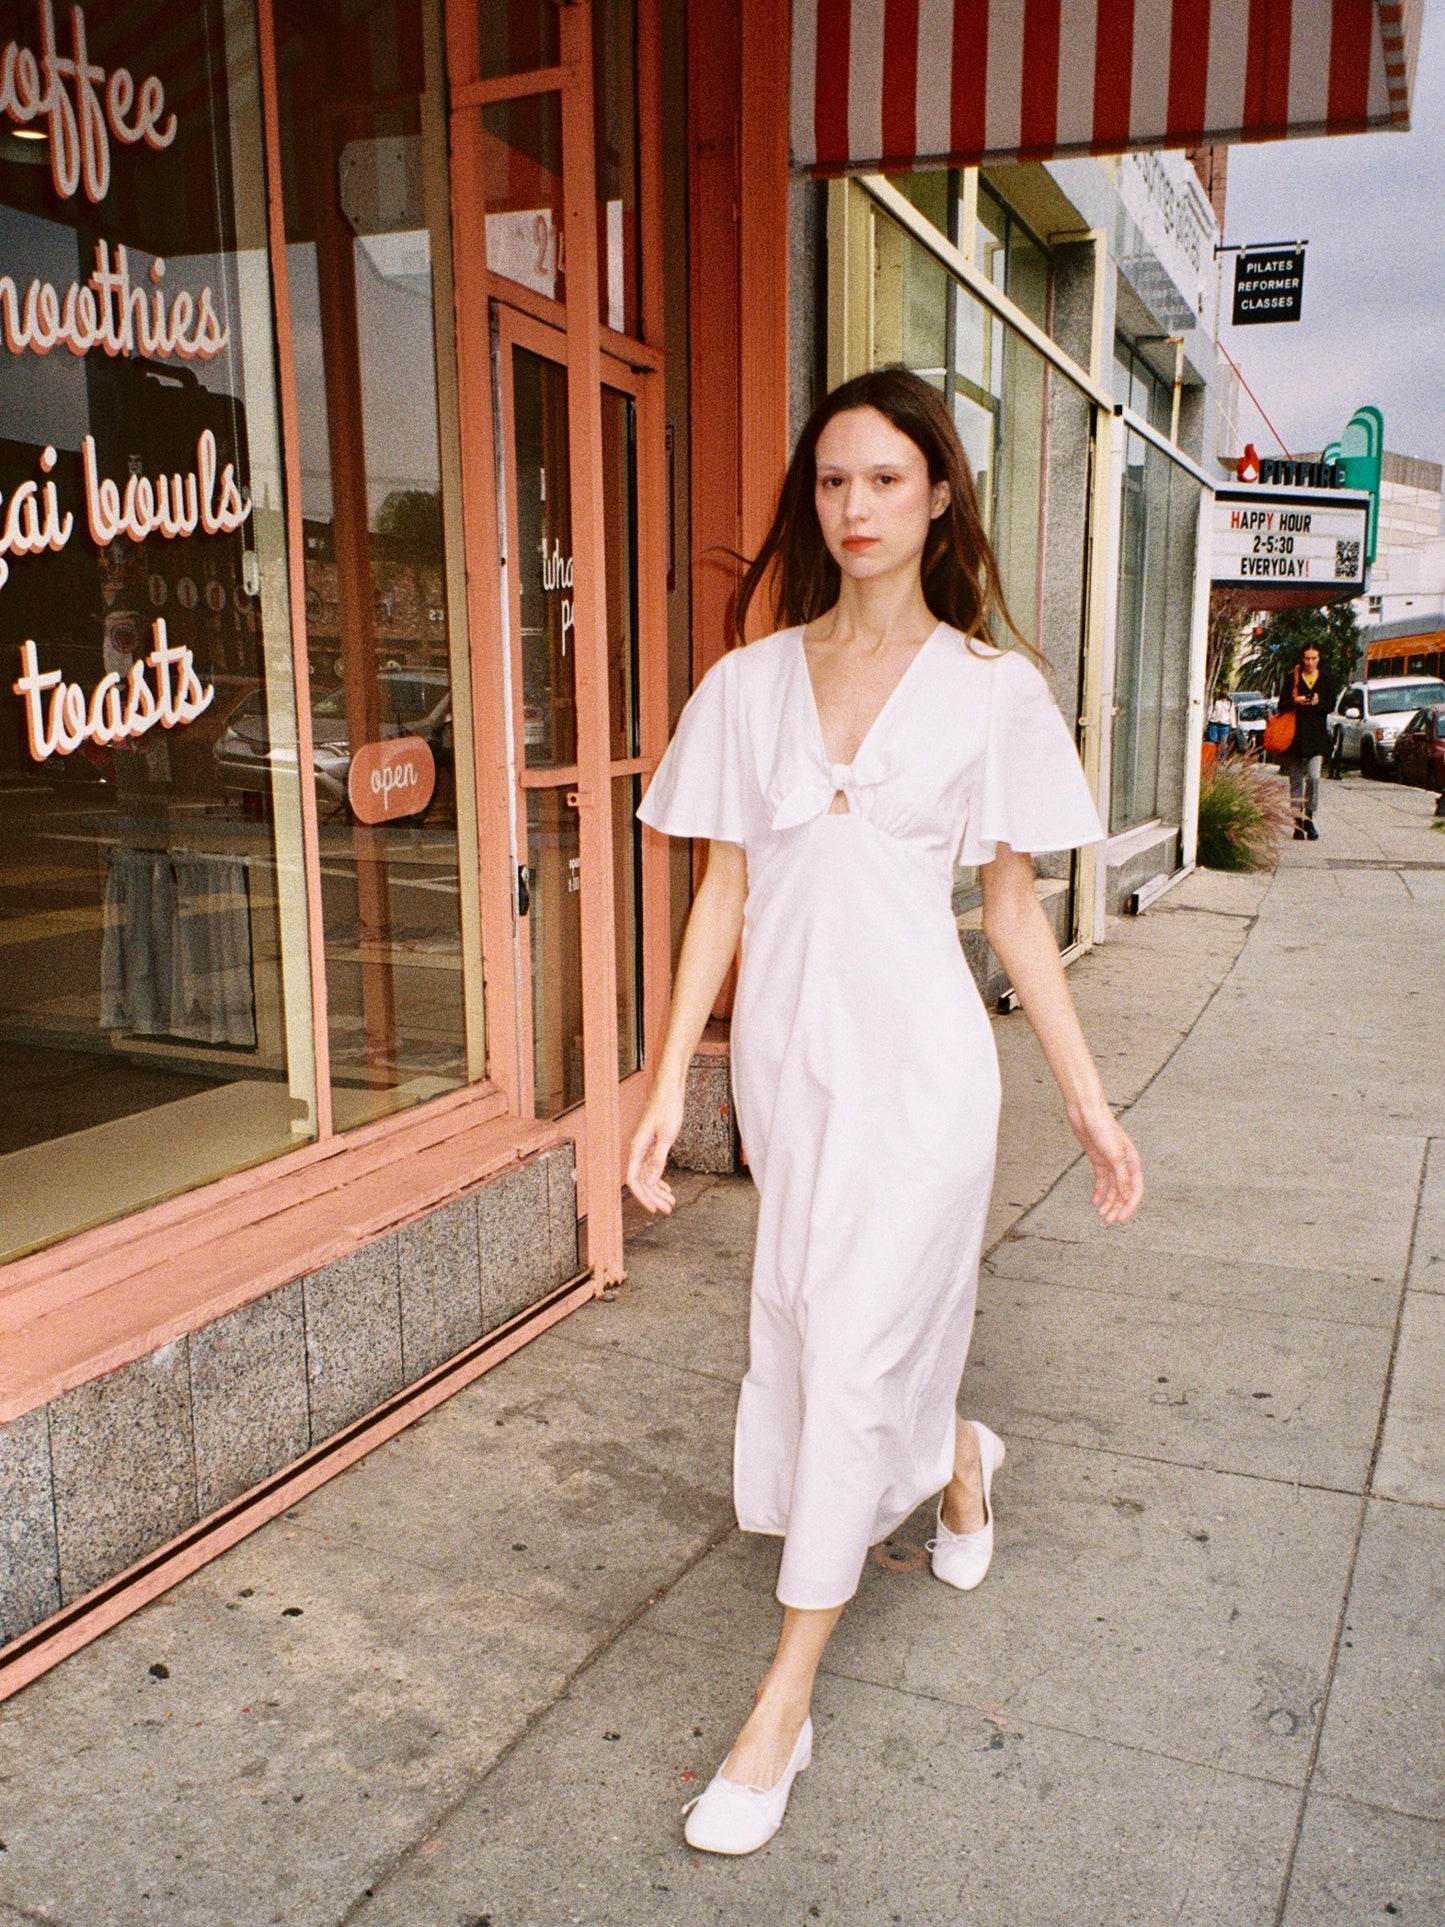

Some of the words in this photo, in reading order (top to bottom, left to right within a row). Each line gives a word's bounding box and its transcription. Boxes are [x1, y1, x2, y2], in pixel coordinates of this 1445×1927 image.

[0, 0, 178, 203] offee
[1246, 260, 1293, 273] PILATES
[1237, 278, 1300, 292] REFORMER
[1241, 297, 1294, 310] CLASSES
[1259, 459, 1346, 489] PITFIRE
[0, 445, 73, 590] ai
[82, 429, 251, 547] bowls
[1231, 511, 1274, 529] HAPPY
[1279, 514, 1312, 532] HOUR
[1253, 535, 1294, 554] 2-5:30
[543, 538, 573, 591] wha
[1241, 558, 1309, 577] EVERYDAY!
[13, 617, 215, 762] toasts
[371, 763, 418, 811] open
